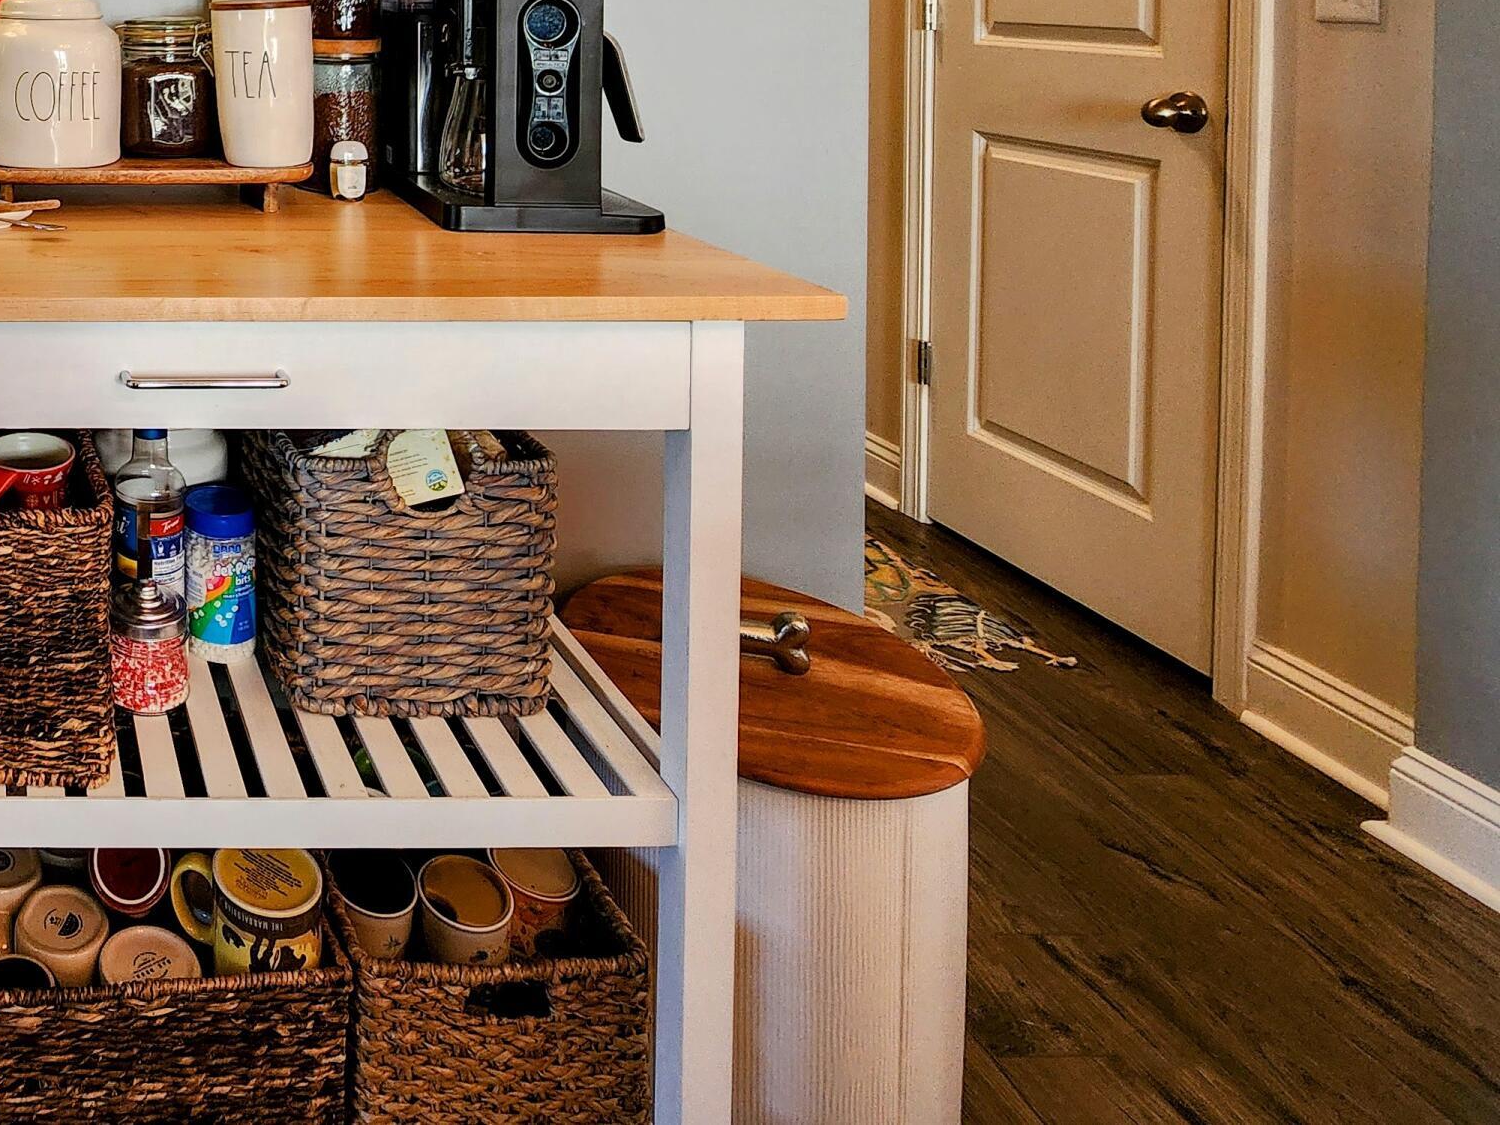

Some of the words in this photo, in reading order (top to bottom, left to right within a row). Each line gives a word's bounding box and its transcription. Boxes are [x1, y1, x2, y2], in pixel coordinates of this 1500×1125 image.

[223, 50, 277, 99] TEA
[14, 71, 101, 122] COFFEE
[235, 574, 252, 586] bits
[271, 922, 284, 932] THE
